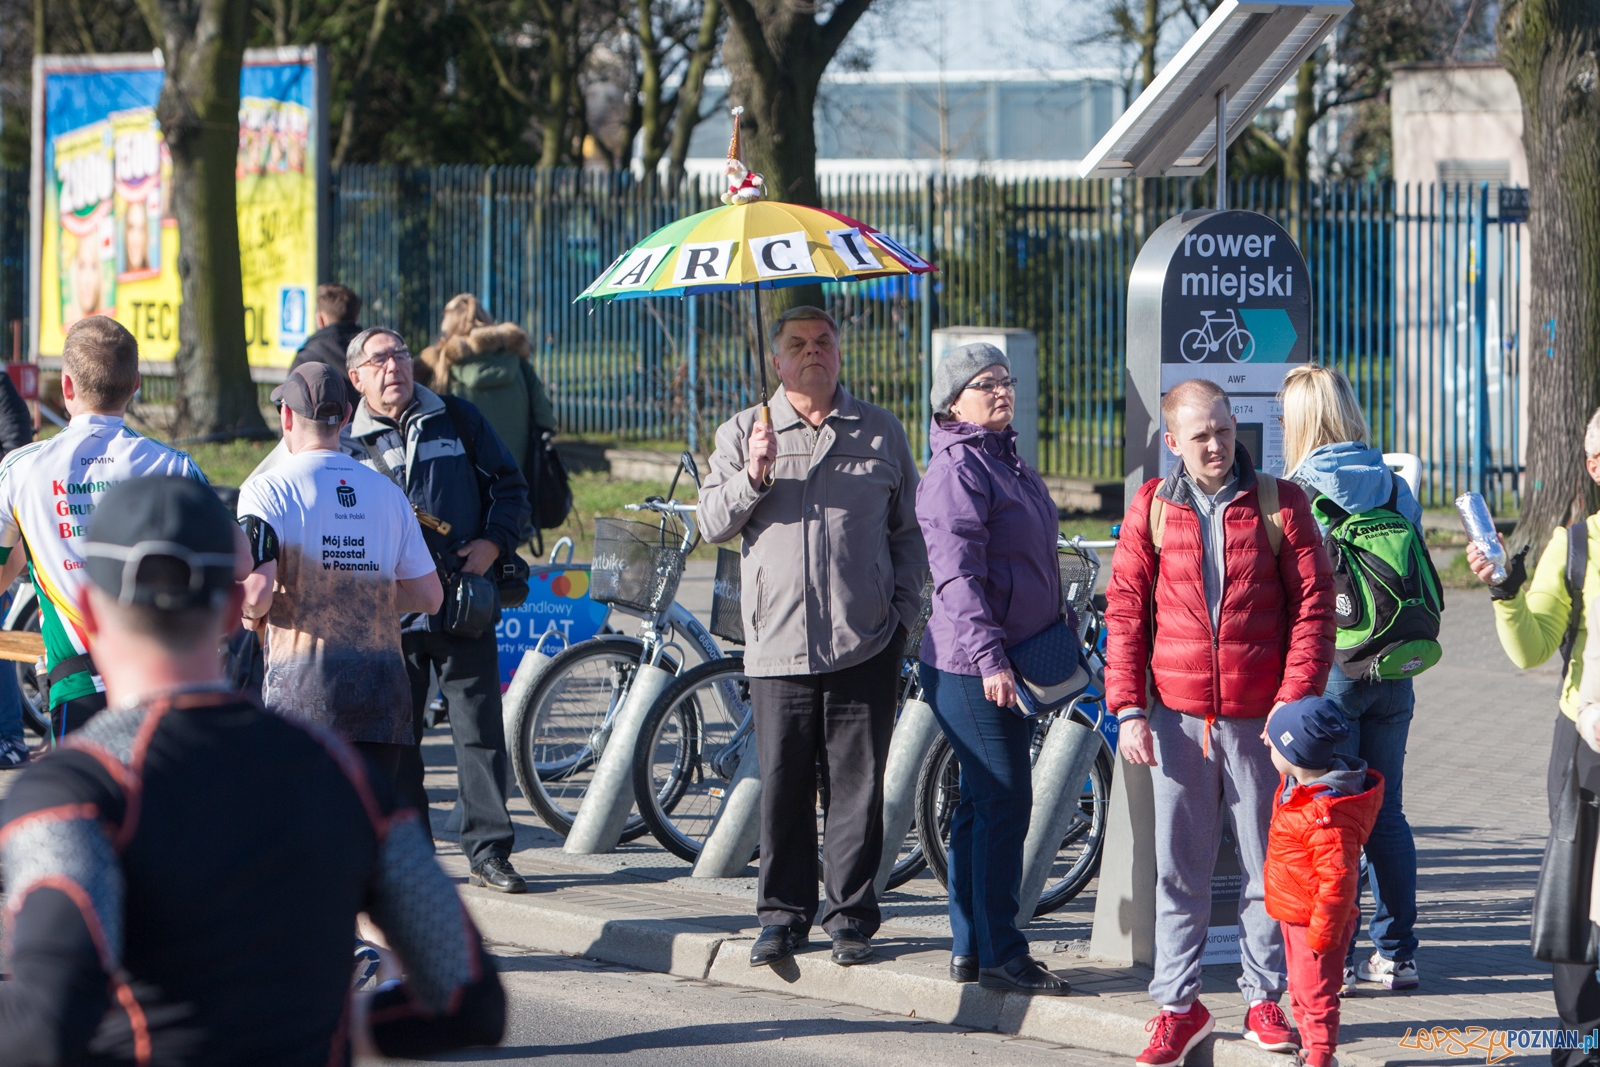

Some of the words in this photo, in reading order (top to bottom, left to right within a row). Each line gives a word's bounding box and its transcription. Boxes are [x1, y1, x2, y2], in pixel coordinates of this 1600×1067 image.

[1184, 233, 1276, 258] rower
[1181, 265, 1293, 304] miejski
[1227, 375, 1247, 384] AWF
[81, 456, 115, 466] DOMIN
[52, 479, 120, 496] KOMORN
[56, 500, 95, 517] GRUP
[335, 512, 348, 520] Bank
[1349, 521, 1408, 540] Kawasaki
[1365, 531, 1389, 540] Racing
[322, 535, 340, 549] Mój
[343, 535, 365, 547] ślad
[322, 548, 366, 560] pozostał
[63, 558, 86, 571] GRZ
[333, 560, 380, 572] Poznaniu
[529, 619, 574, 640] LAT
